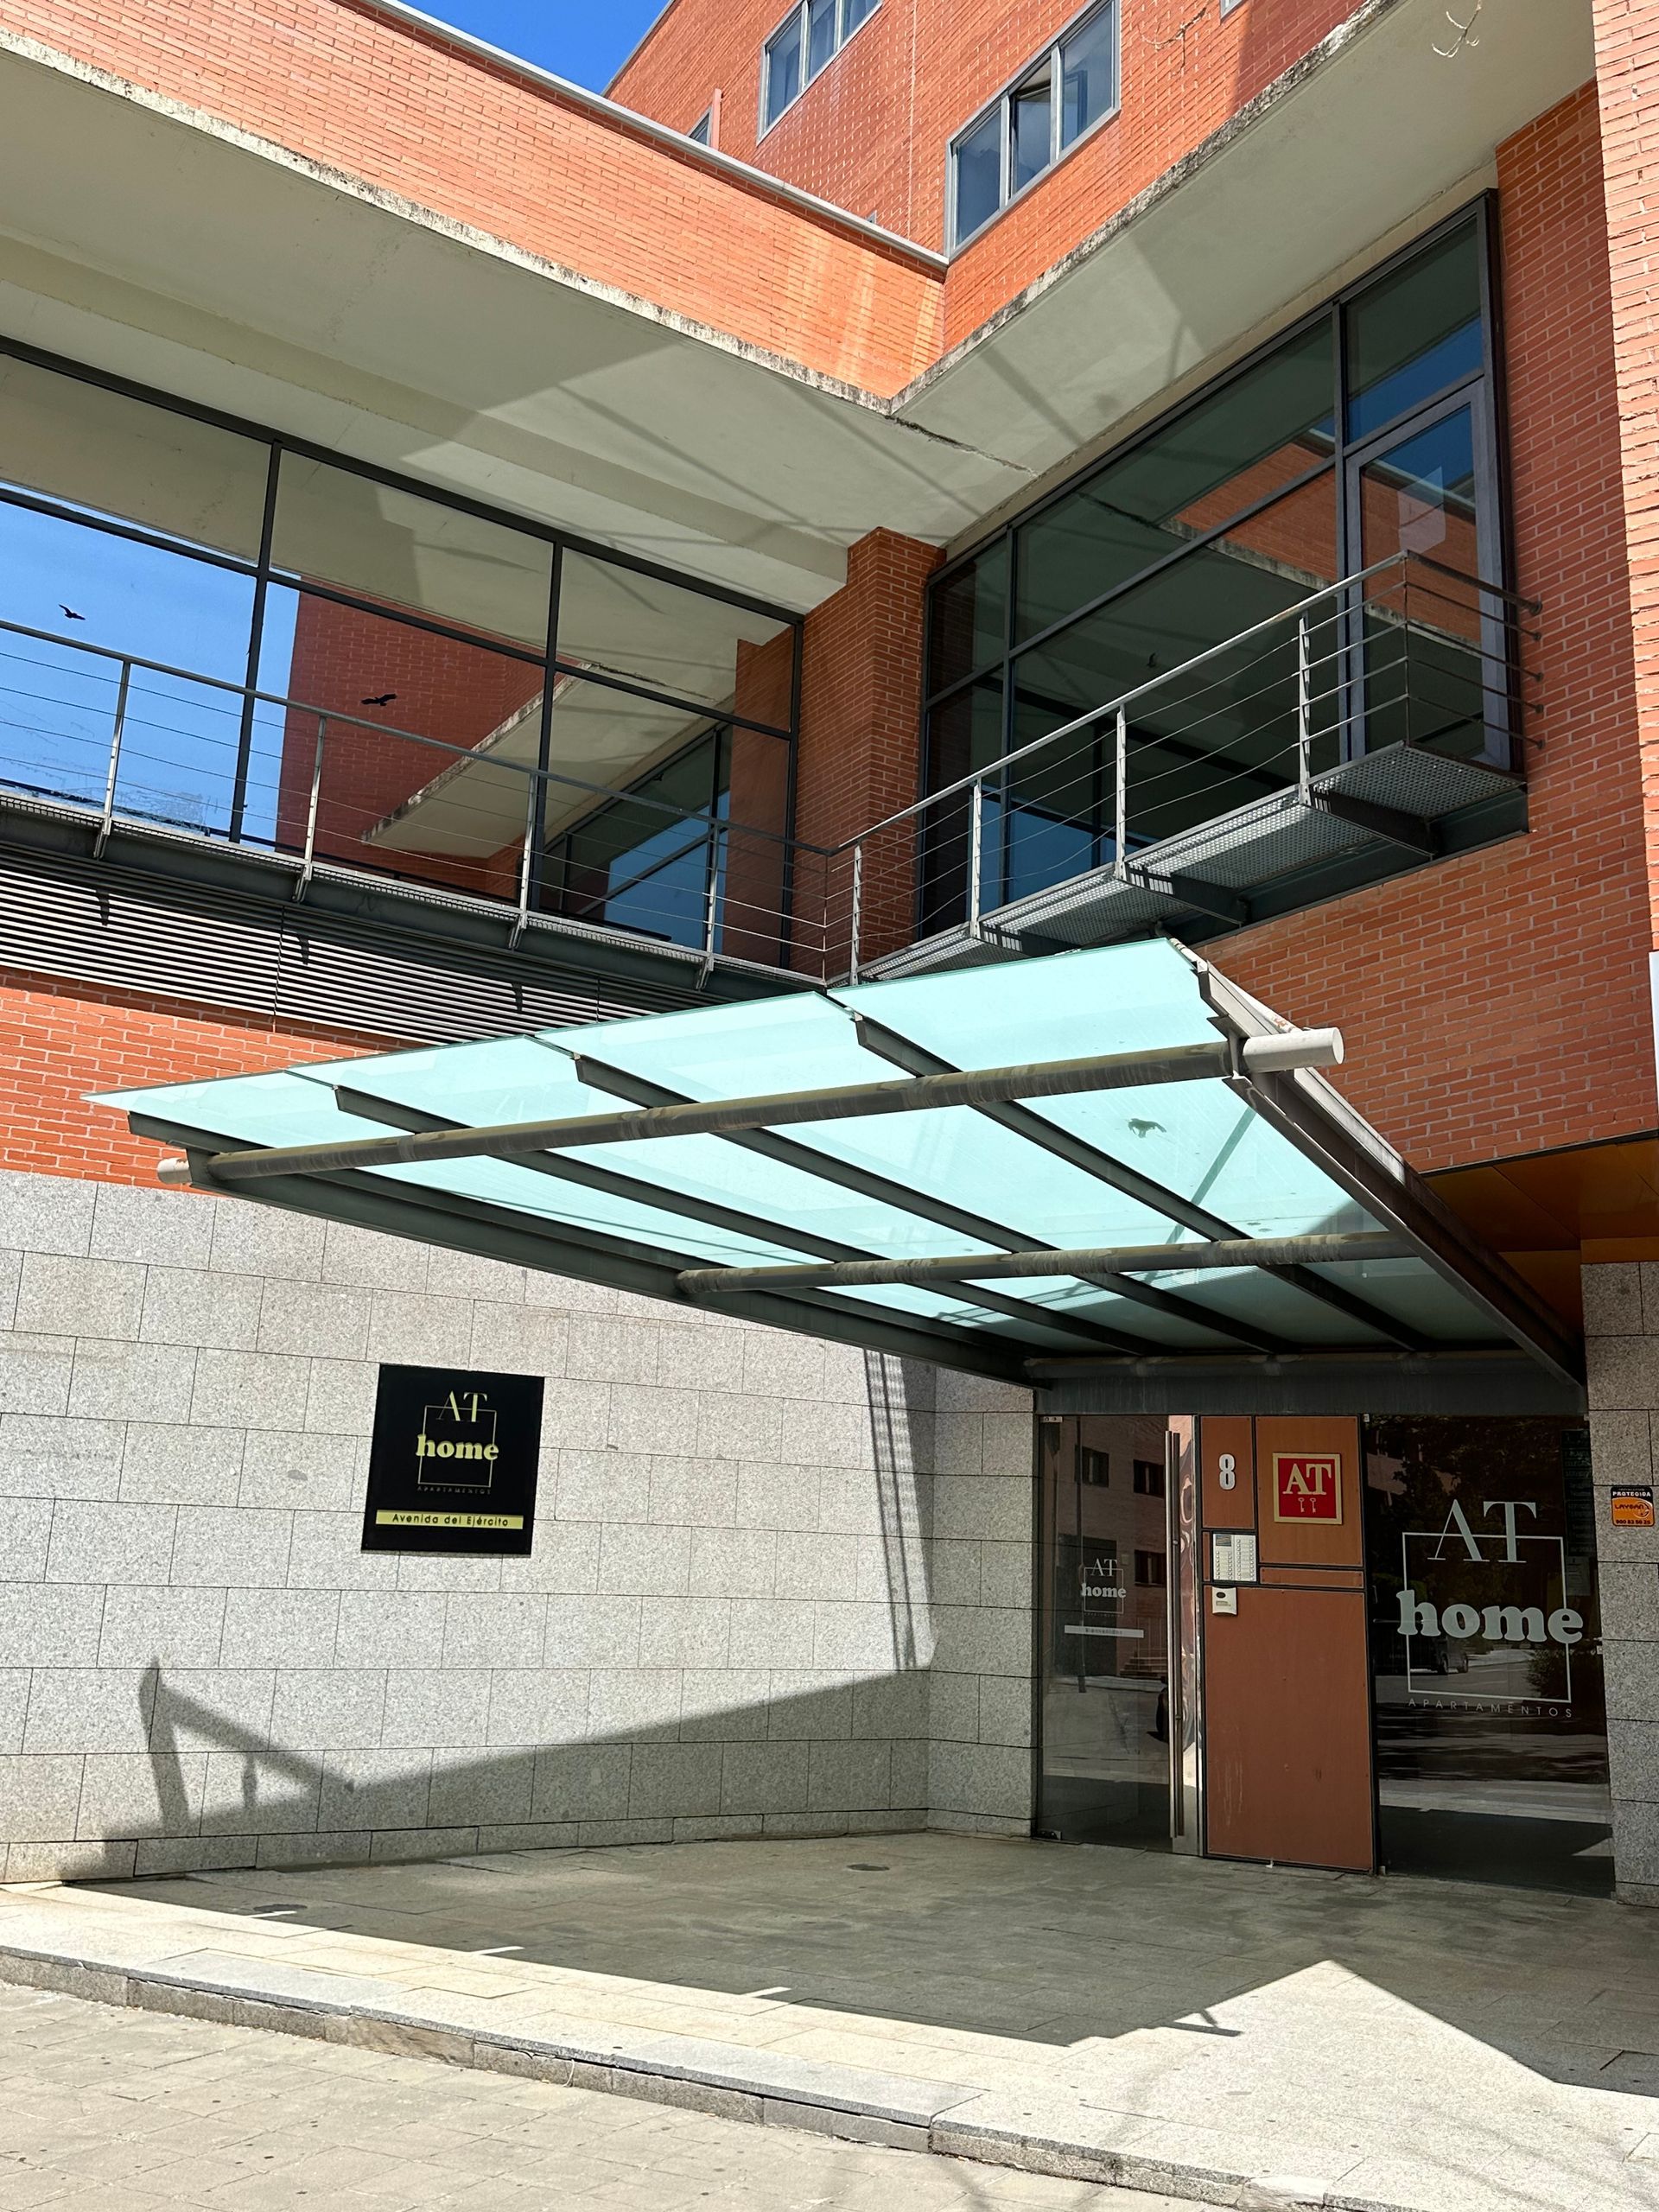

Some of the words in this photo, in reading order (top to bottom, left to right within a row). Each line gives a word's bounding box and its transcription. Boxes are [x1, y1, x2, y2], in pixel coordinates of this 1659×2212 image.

[435, 1390, 488, 1422] AT
[416, 1433, 499, 1460] home
[1218, 1453, 1236, 1491] 8
[1282, 1463, 1332, 1496] AT
[416, 1485, 492, 1495] APARTAMENTOS
[392, 1513, 439, 1524] Avenida
[443, 1516, 462, 1525] del
[467, 1516, 509, 1528] Ejército
[1427, 1498, 1537, 1563] AT
[1090, 1558, 1118, 1577] AT
[1081, 1582, 1127, 1599] home
[1395, 1589, 1584, 1643] home
[1408, 1698, 1573, 1719] APARTAMENTOS
